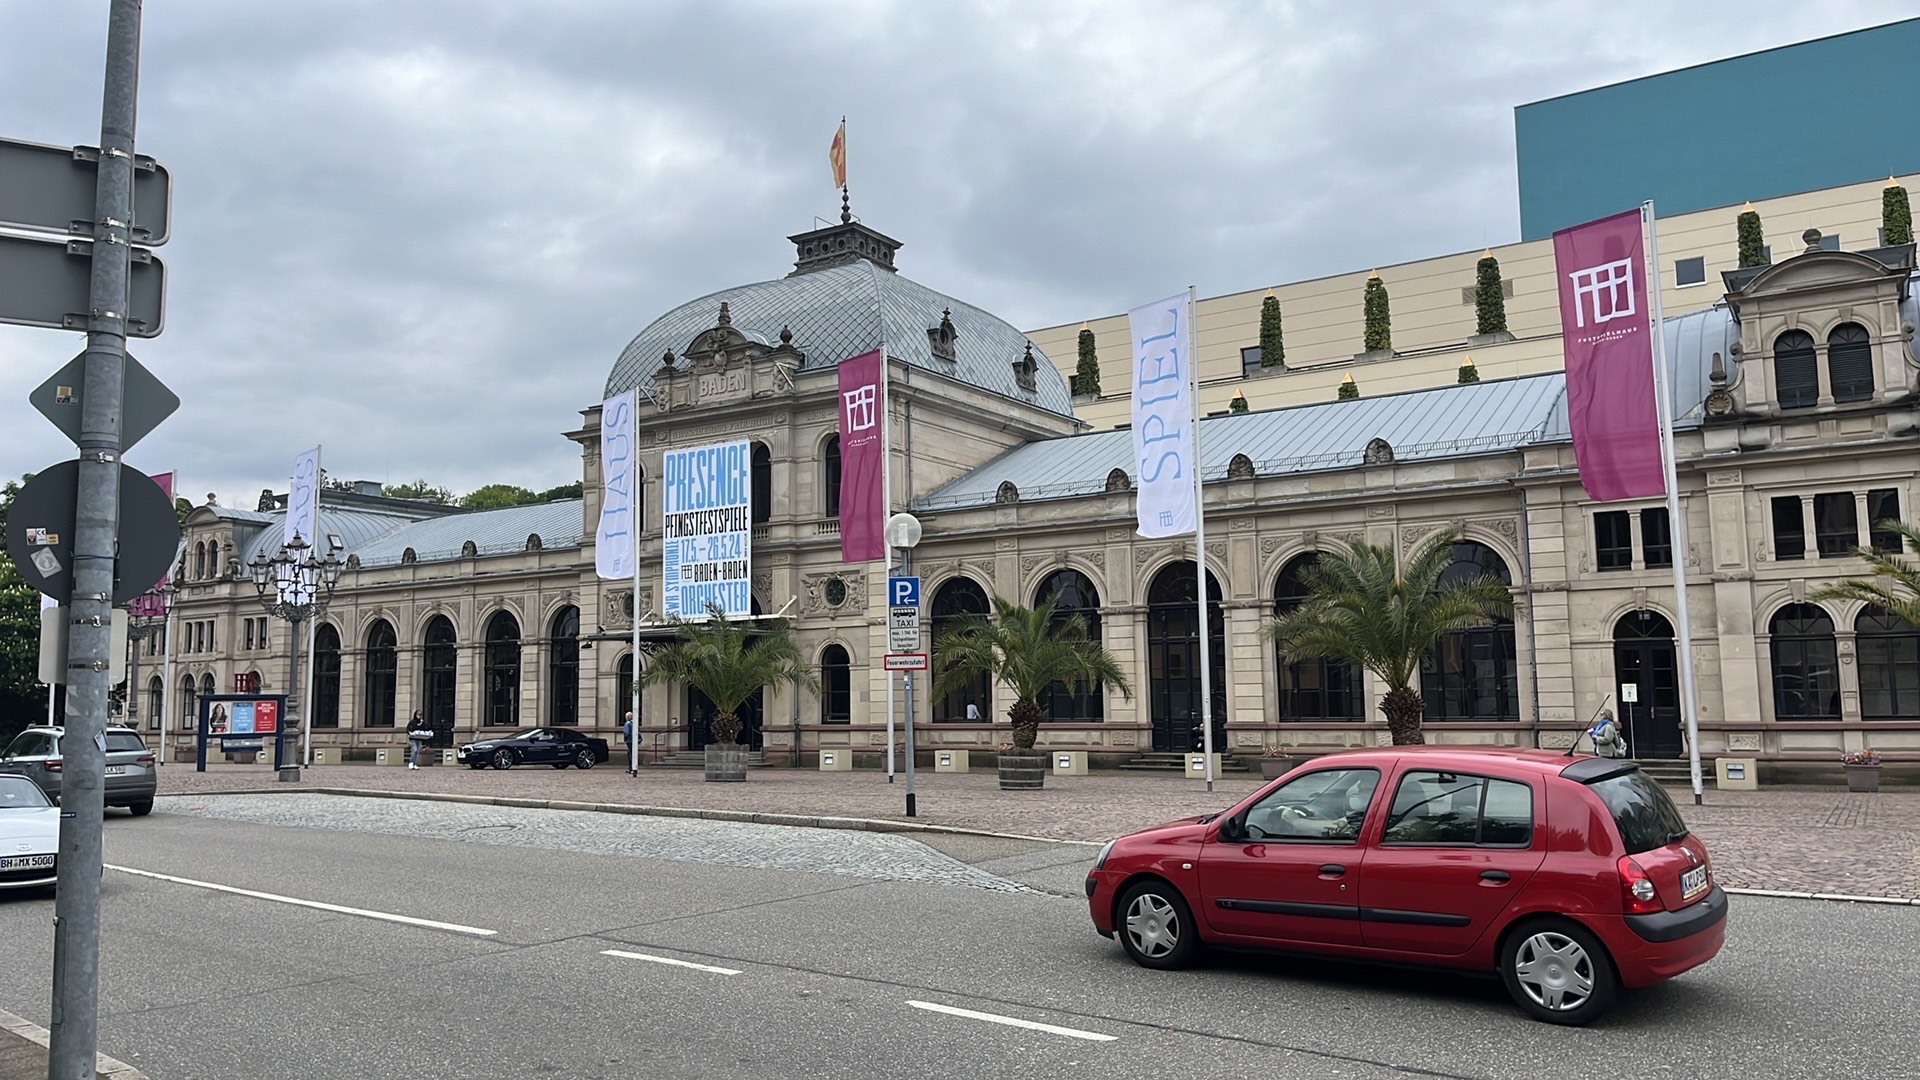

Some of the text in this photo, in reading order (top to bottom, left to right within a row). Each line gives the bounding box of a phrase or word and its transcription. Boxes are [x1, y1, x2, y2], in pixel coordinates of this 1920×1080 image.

[700, 372, 747, 398] BADEN
[1139, 308, 1182, 484] SPIEL
[666, 443, 748, 512] PRESENCE
[665, 506, 748, 538] PFINGSTFESTSPIELE
[681, 538, 700, 563] 17.5.
[707, 534, 742, 560] 26.5.24
[665, 540, 680, 592] SYMPHONIE
[694, 560, 748, 582] BADEN-BADEN
[681, 581, 748, 615] ORCHESTER
[895, 581, 913, 604] P
[896, 619, 914, 627] TAXI
[19, 857, 31, 867] MX
[31, 856, 53, 866] 5000
